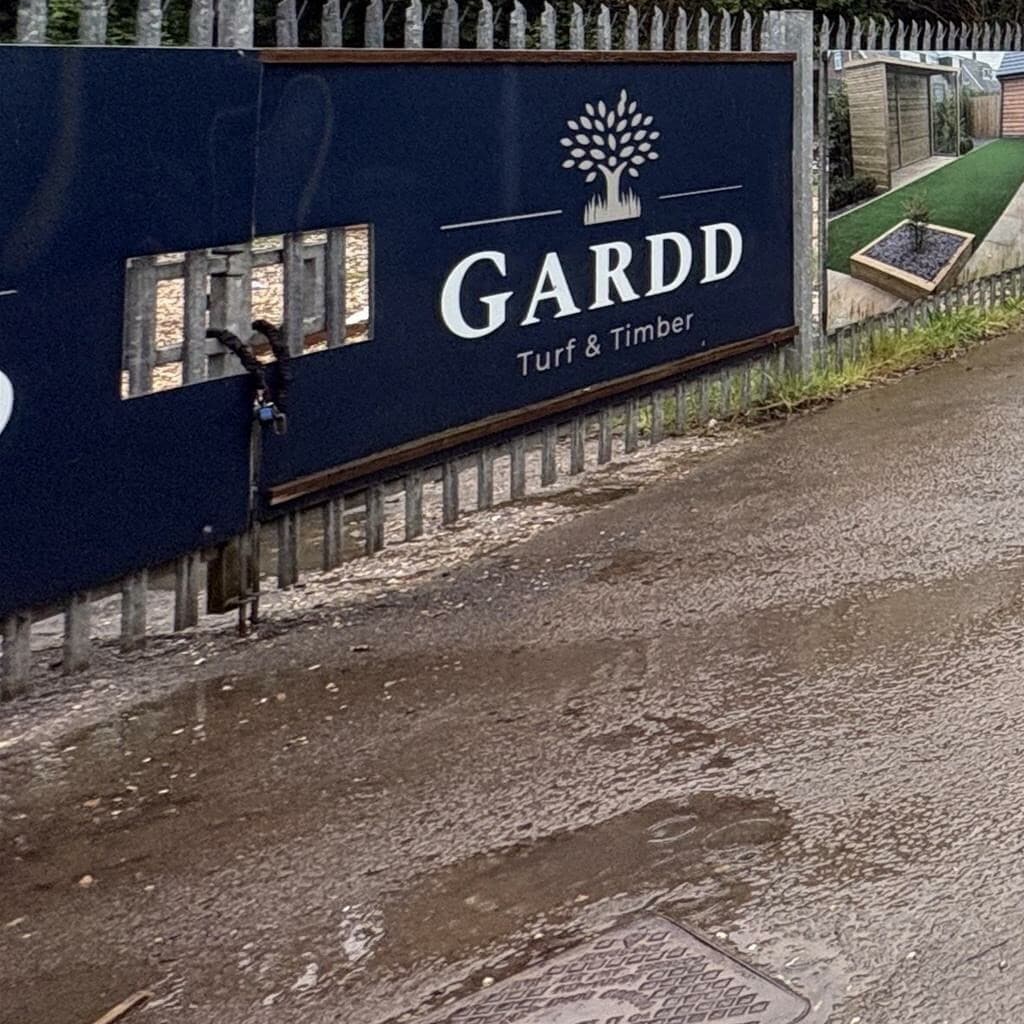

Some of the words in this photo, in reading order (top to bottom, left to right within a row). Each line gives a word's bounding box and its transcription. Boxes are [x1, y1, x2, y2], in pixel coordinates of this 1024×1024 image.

[440, 222, 744, 340] GARDD
[516, 338, 577, 377] Turf
[585, 333, 601, 359] &
[610, 311, 695, 352] Timber
